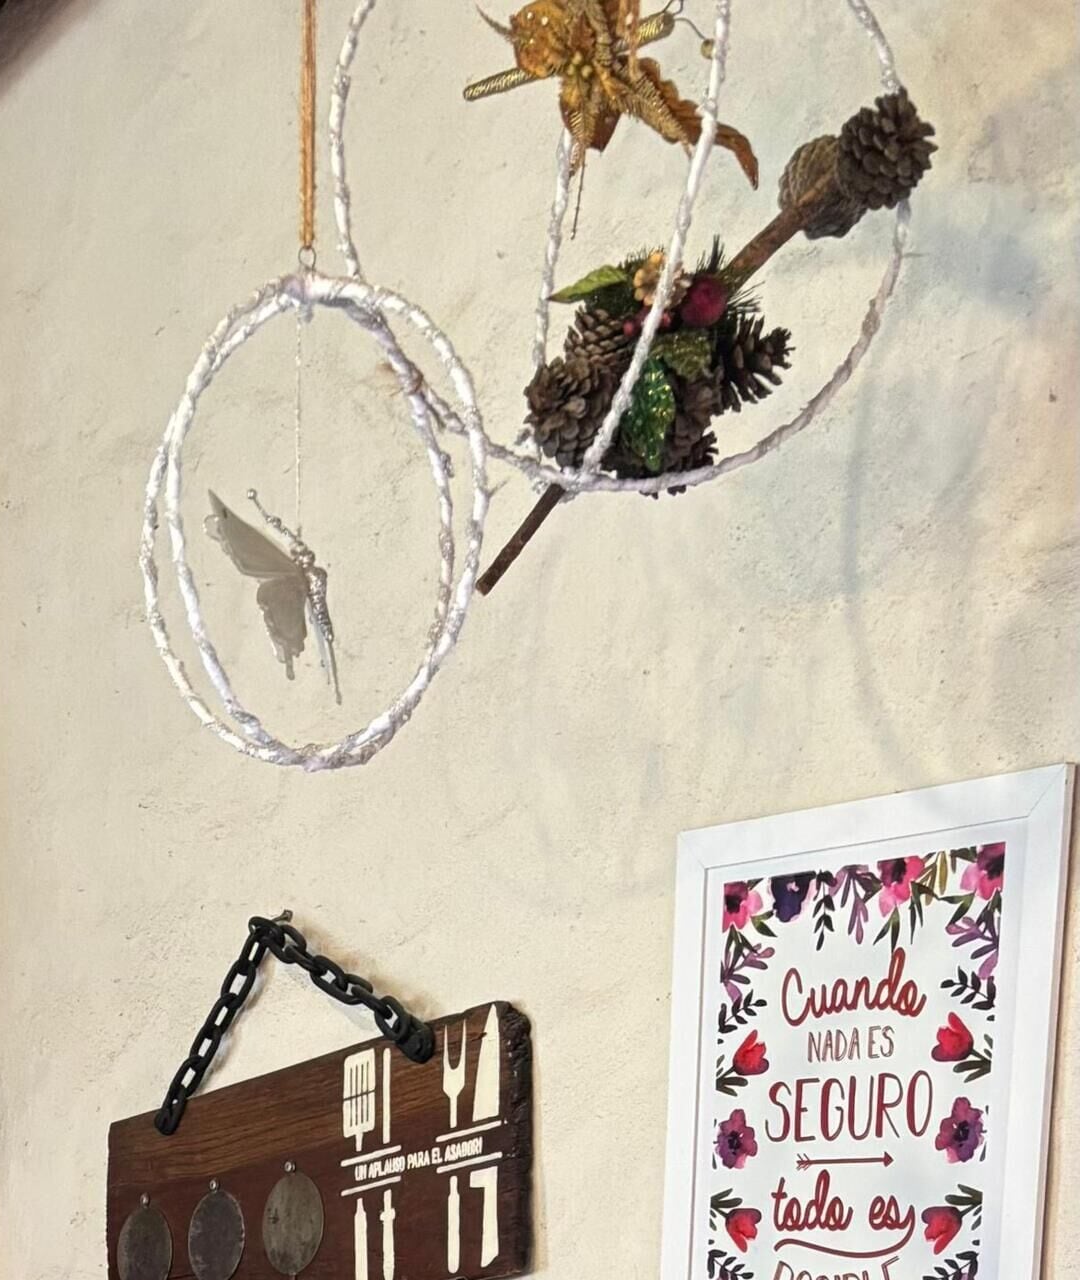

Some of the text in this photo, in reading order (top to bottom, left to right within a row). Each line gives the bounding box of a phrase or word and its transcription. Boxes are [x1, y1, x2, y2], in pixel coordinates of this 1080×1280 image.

[782, 947, 927, 1026] Cuando
[807, 1025, 895, 1063] NADA ES
[765, 1070, 933, 1142] SEGURO
[354, 1164, 367, 1181] UN
[368, 1155, 406, 1178] APLAUSO
[407, 1150, 430, 1169] PARA
[431, 1147, 443, 1164] EL
[771, 1169, 916, 1232] todo es
